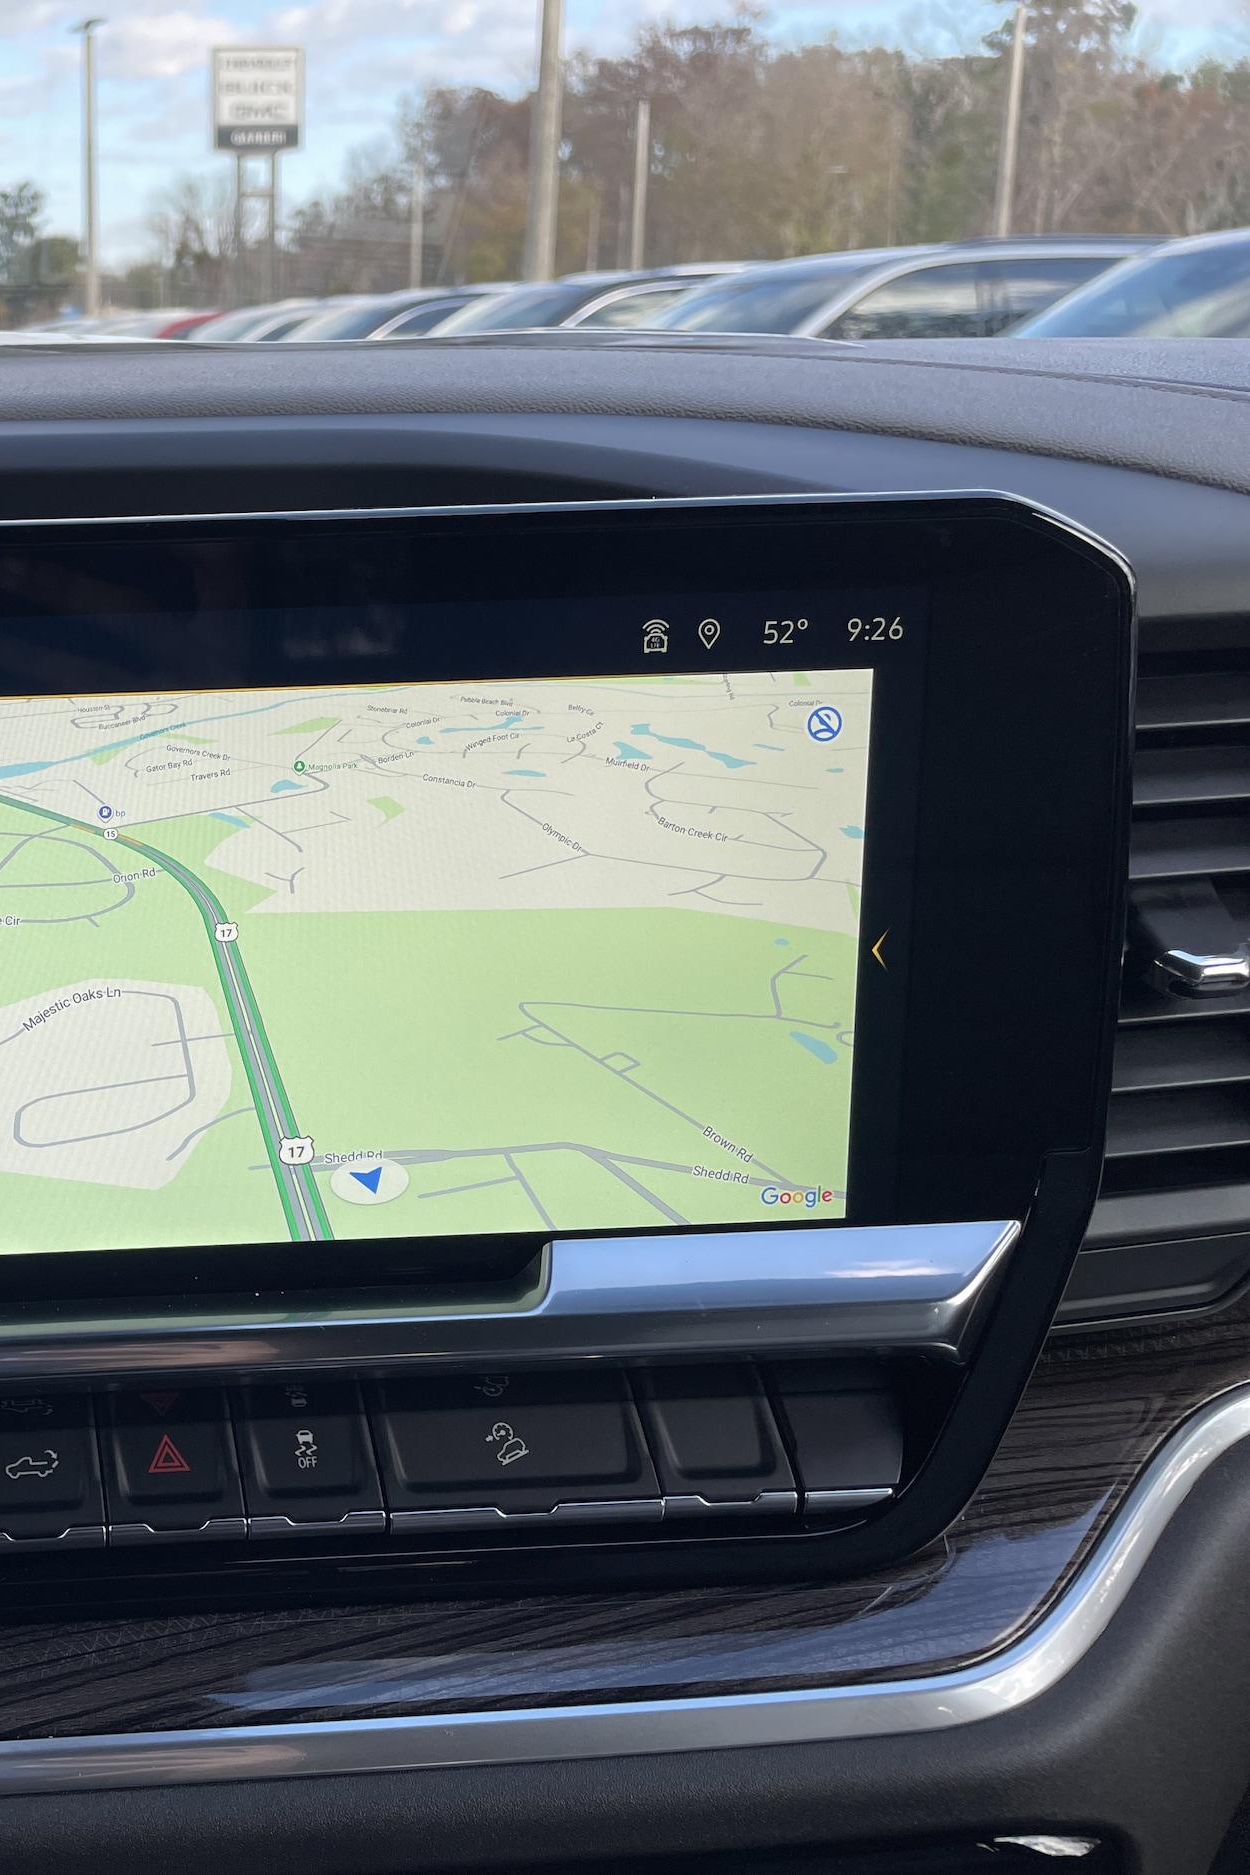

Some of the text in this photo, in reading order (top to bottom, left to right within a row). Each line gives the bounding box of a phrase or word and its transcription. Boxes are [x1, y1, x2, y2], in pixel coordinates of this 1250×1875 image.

[763, 618, 809, 645] 52°
[846, 616, 904, 642] 9:26
[367, 705, 398, 714] Stonebriar
[98, 715, 146, 730] Buccaneer Blvd
[170, 722, 186, 731] Creek
[405, 718, 431, 729] Colonial
[465, 735, 491, 750] Winged
[492, 733, 508, 742] Foot
[576, 729, 597, 741] Costa
[166, 745, 201, 757] Governors
[201, 750, 221, 760] Creek
[377, 751, 414, 764] Borden Ln
[146, 759, 193, 773] Gator Bay Rd
[308, 762, 341, 771] Magnolia
[606, 757, 650, 772] Muirfield Dr
[191, 768, 230, 781] Travers Rd
[422, 774, 476, 789] Constancia Dr
[115, 809, 126, 818] bp
[106, 830, 115, 838] 15
[657, 816, 728, 842] Barton Creek Cir
[541, 822, 582, 852] Olympic Dr
[113, 867, 156, 884] Orion Rd
[5, 915, 21, 926] Cir
[220, 928, 232, 938] 17
[22, 986, 121, 1032] Majestic Oaks Ln
[702, 1125, 753, 1163] Brown Rd
[288, 1146, 305, 1158] 17
[324, 1150, 383, 1164] Shedd Rd
[692, 1165, 750, 1185] Shedd Rd
[761, 1185, 833, 1209] Google
[297, 1456, 318, 1469] OFF
